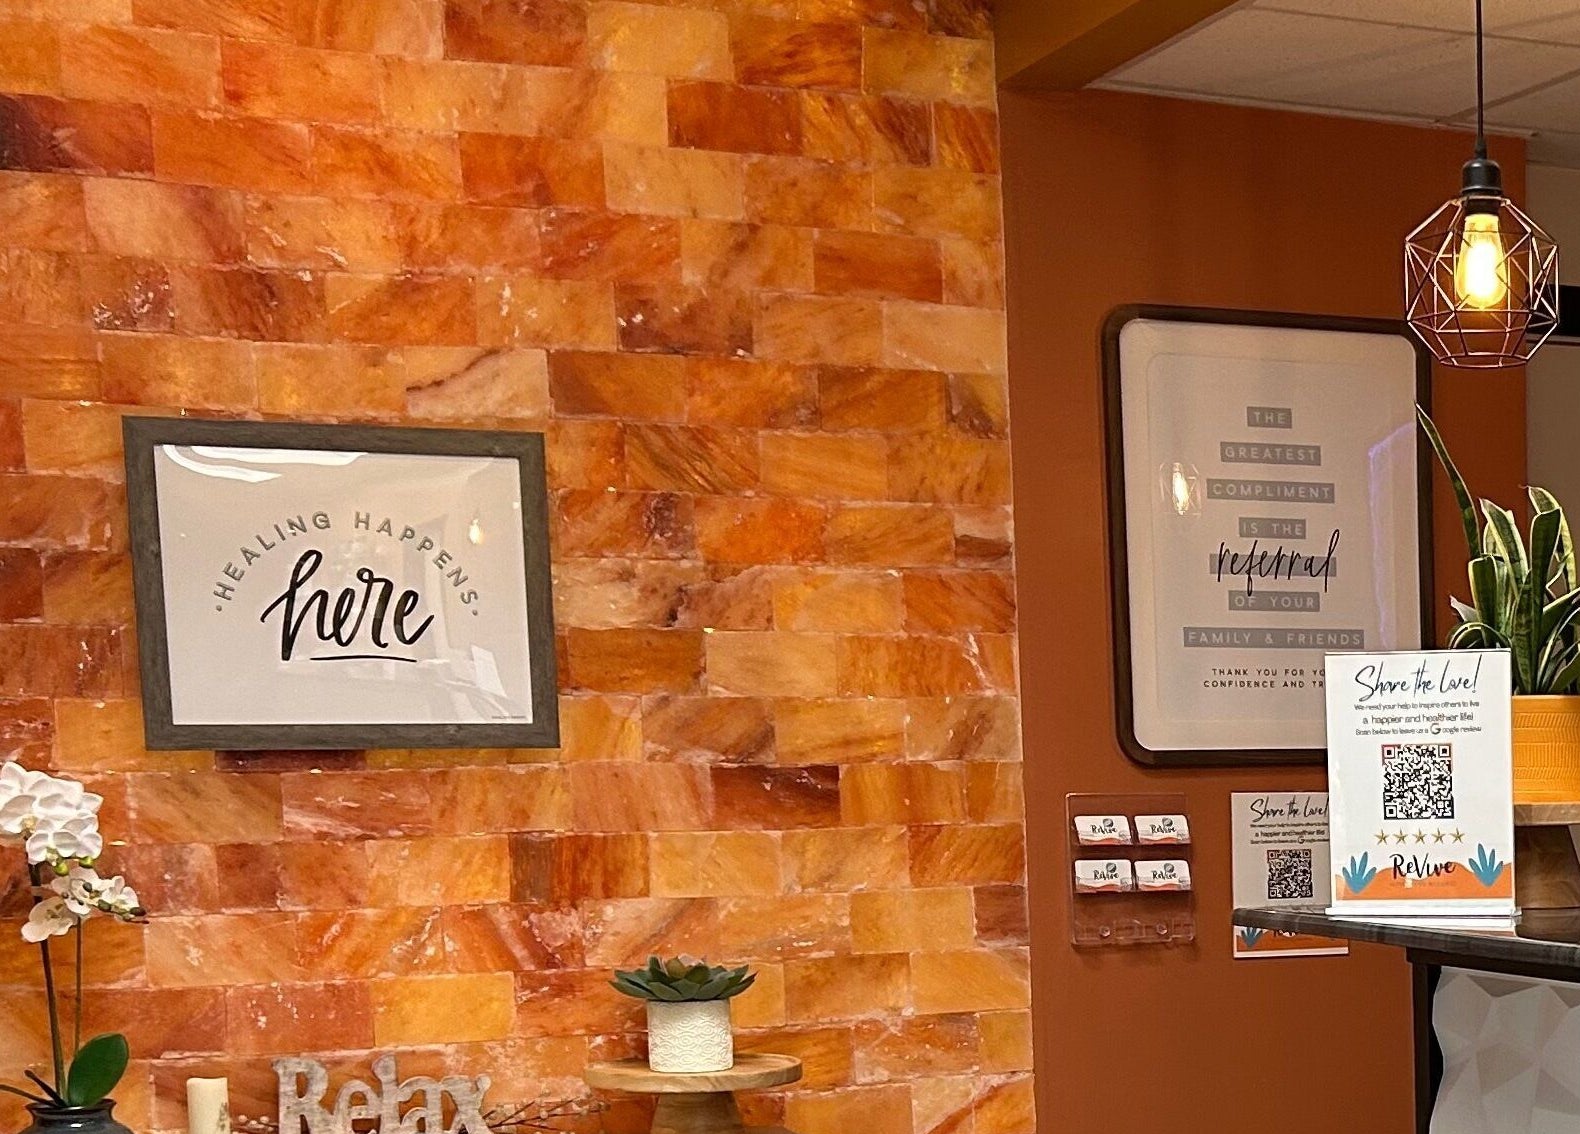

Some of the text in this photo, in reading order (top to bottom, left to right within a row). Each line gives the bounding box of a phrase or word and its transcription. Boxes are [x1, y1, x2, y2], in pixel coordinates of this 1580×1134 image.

[1253, 411, 1286, 424] THE
[1225, 446, 1316, 461] GREATEST
[1212, 483, 1331, 499] COMPLIMENT
[1243, 522, 1303, 536] IS THE
[213, 511, 479, 605] HEALING HAPPENS
[1217, 529, 1340, 597] referral
[260, 549, 435, 661] here
[1234, 595, 1315, 609] OF YOUR
[1188, 631, 1361, 646] FAMILY & FRIENDS
[1211, 668, 1248, 676] THANK
[1257, 668, 1278, 676] YOU
[1354, 654, 1482, 702] Share the Love!
[1203, 680, 1276, 688] CONFIDENCE
